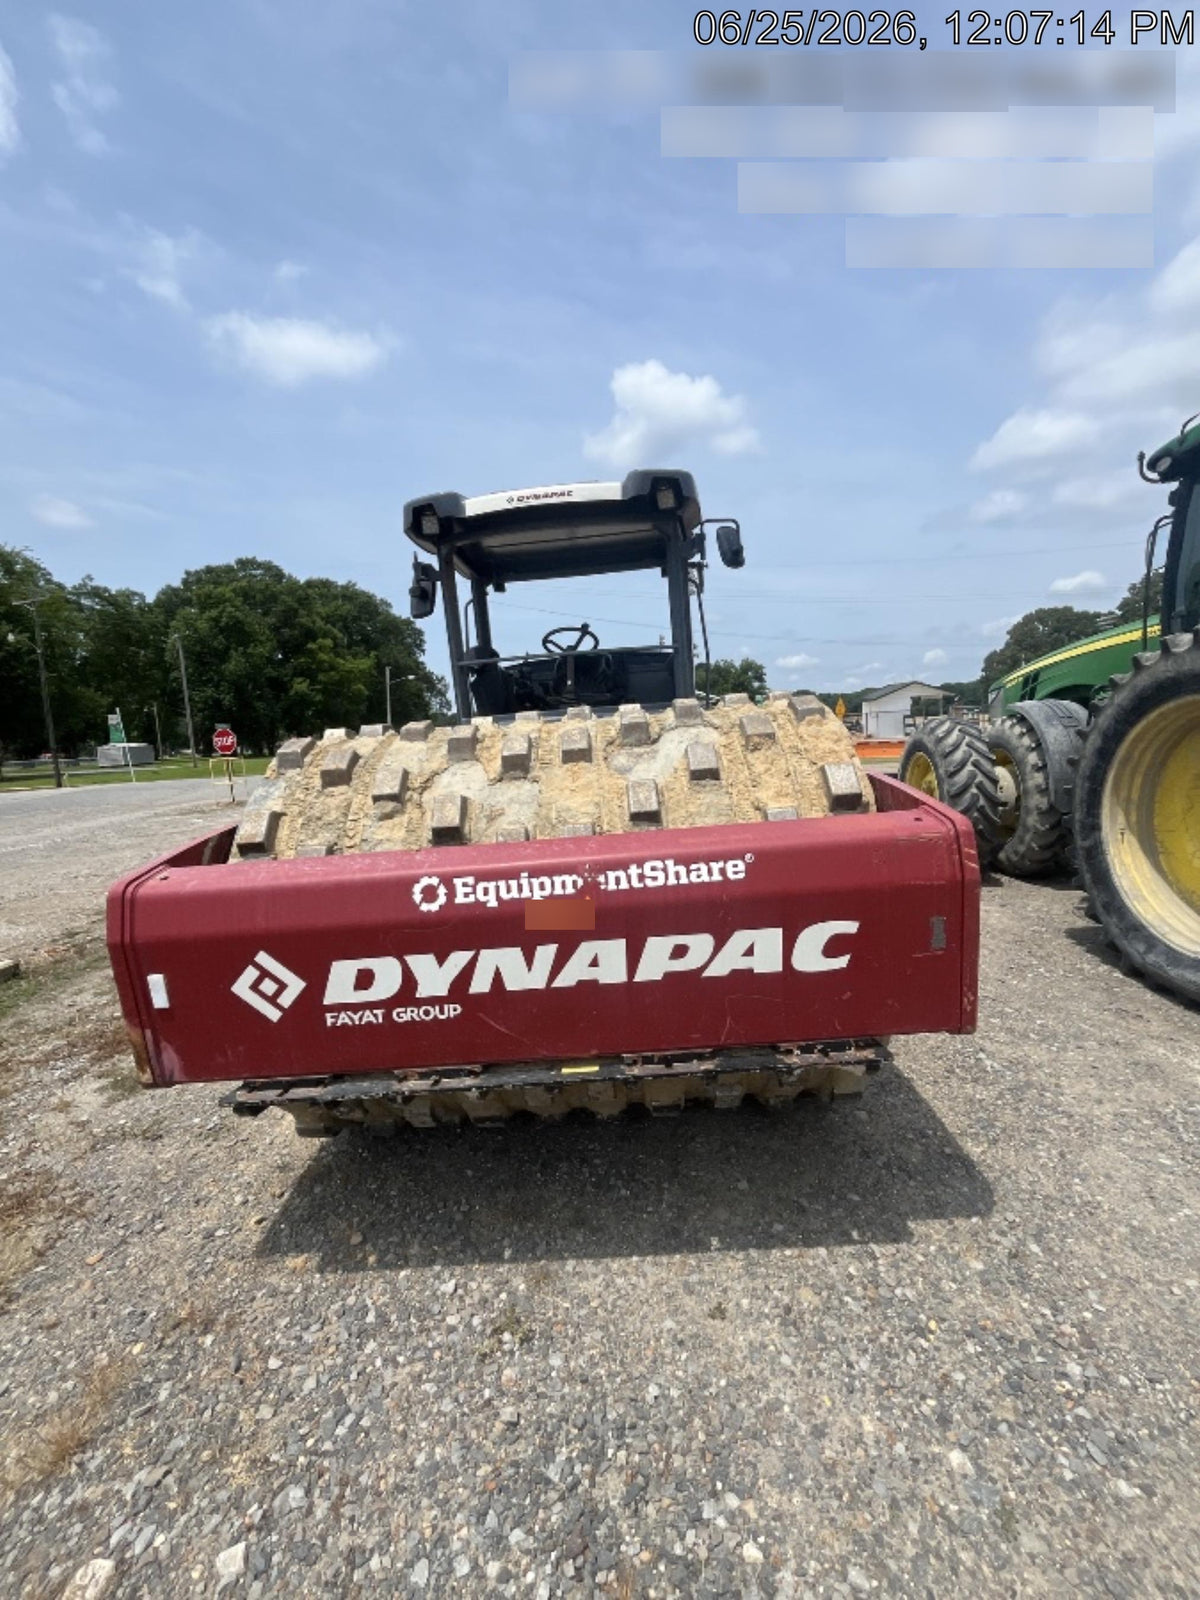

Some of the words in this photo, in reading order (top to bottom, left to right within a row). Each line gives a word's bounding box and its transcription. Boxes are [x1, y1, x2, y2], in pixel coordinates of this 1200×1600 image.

[323, 920, 860, 1005] DYNAPAC
[325, 1009, 385, 1027] FAYAT
[392, 1003, 463, 1023] GROUP
